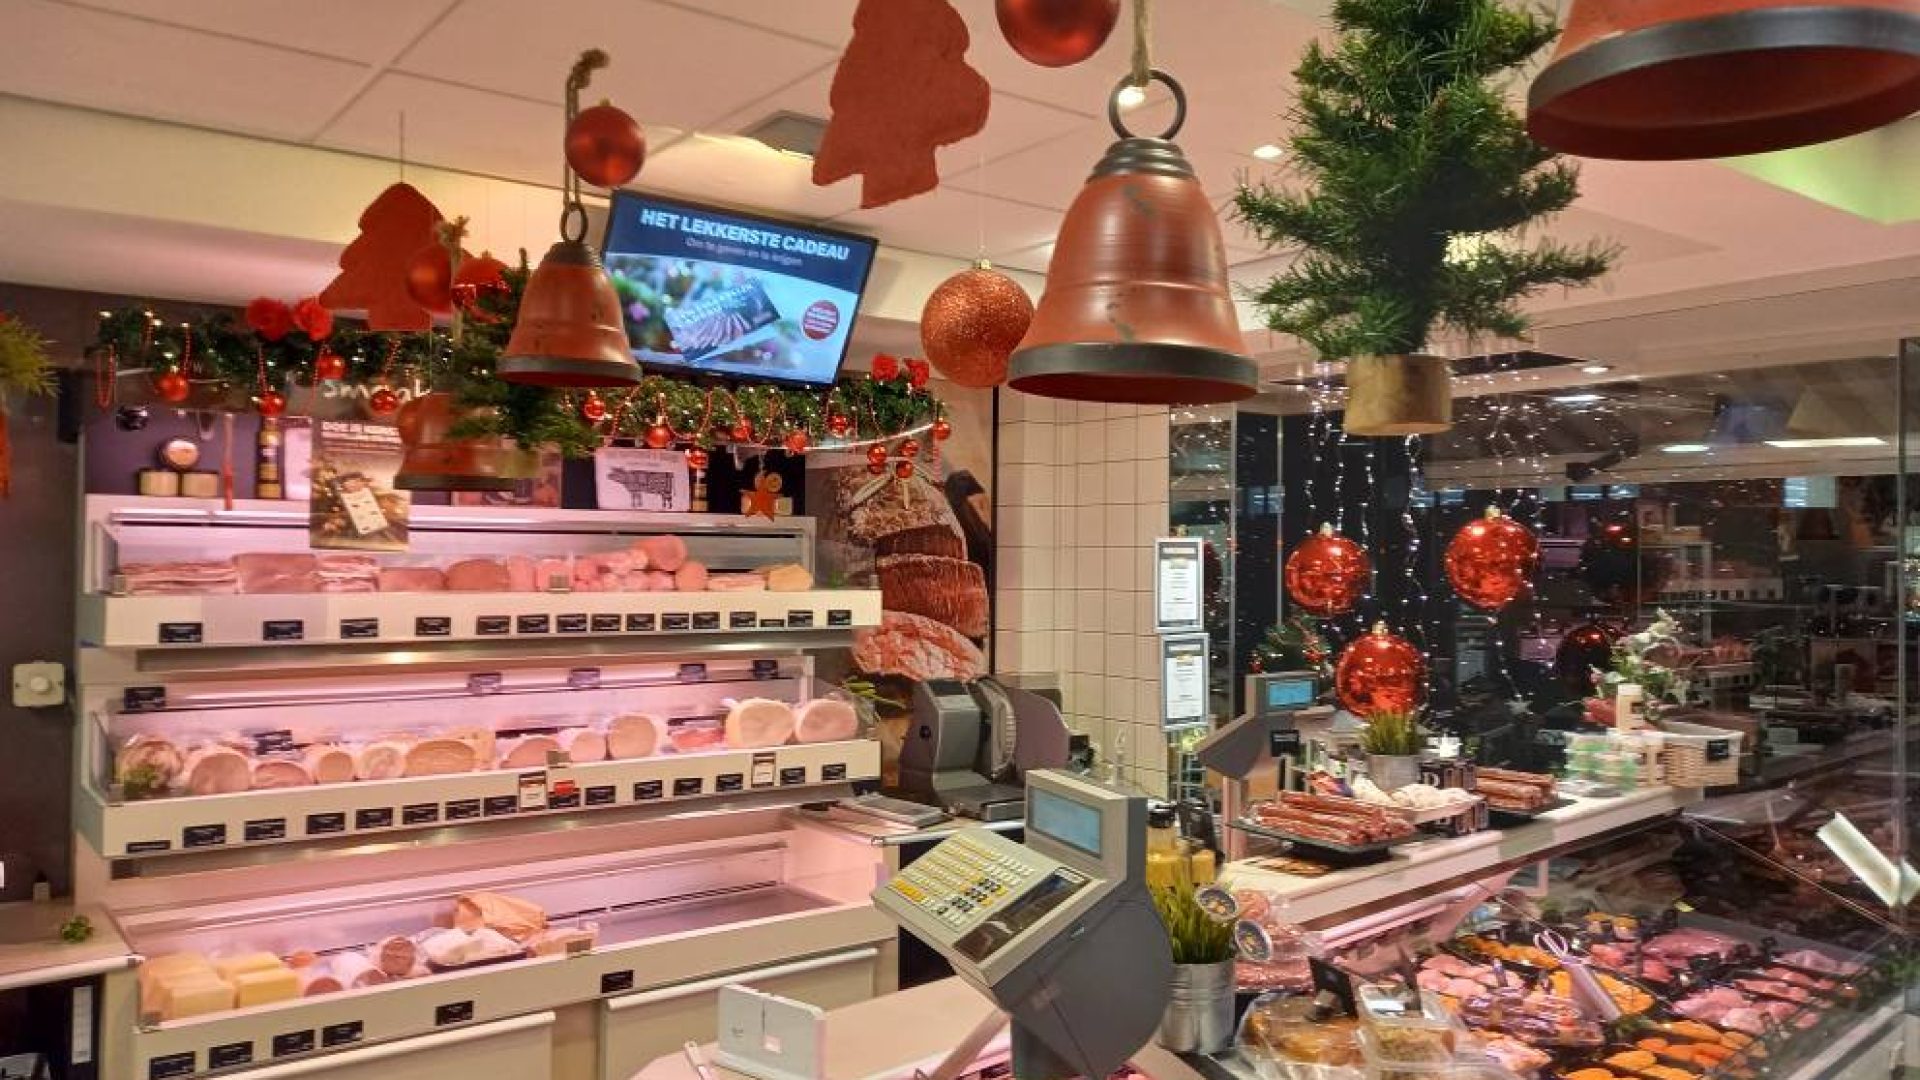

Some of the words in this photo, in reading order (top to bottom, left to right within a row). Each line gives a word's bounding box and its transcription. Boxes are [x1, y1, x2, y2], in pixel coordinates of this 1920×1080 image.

[640, 208, 680, 229] HET
[681, 214, 782, 248] LEKKERSTE
[782, 235, 850, 260] CADEAU
